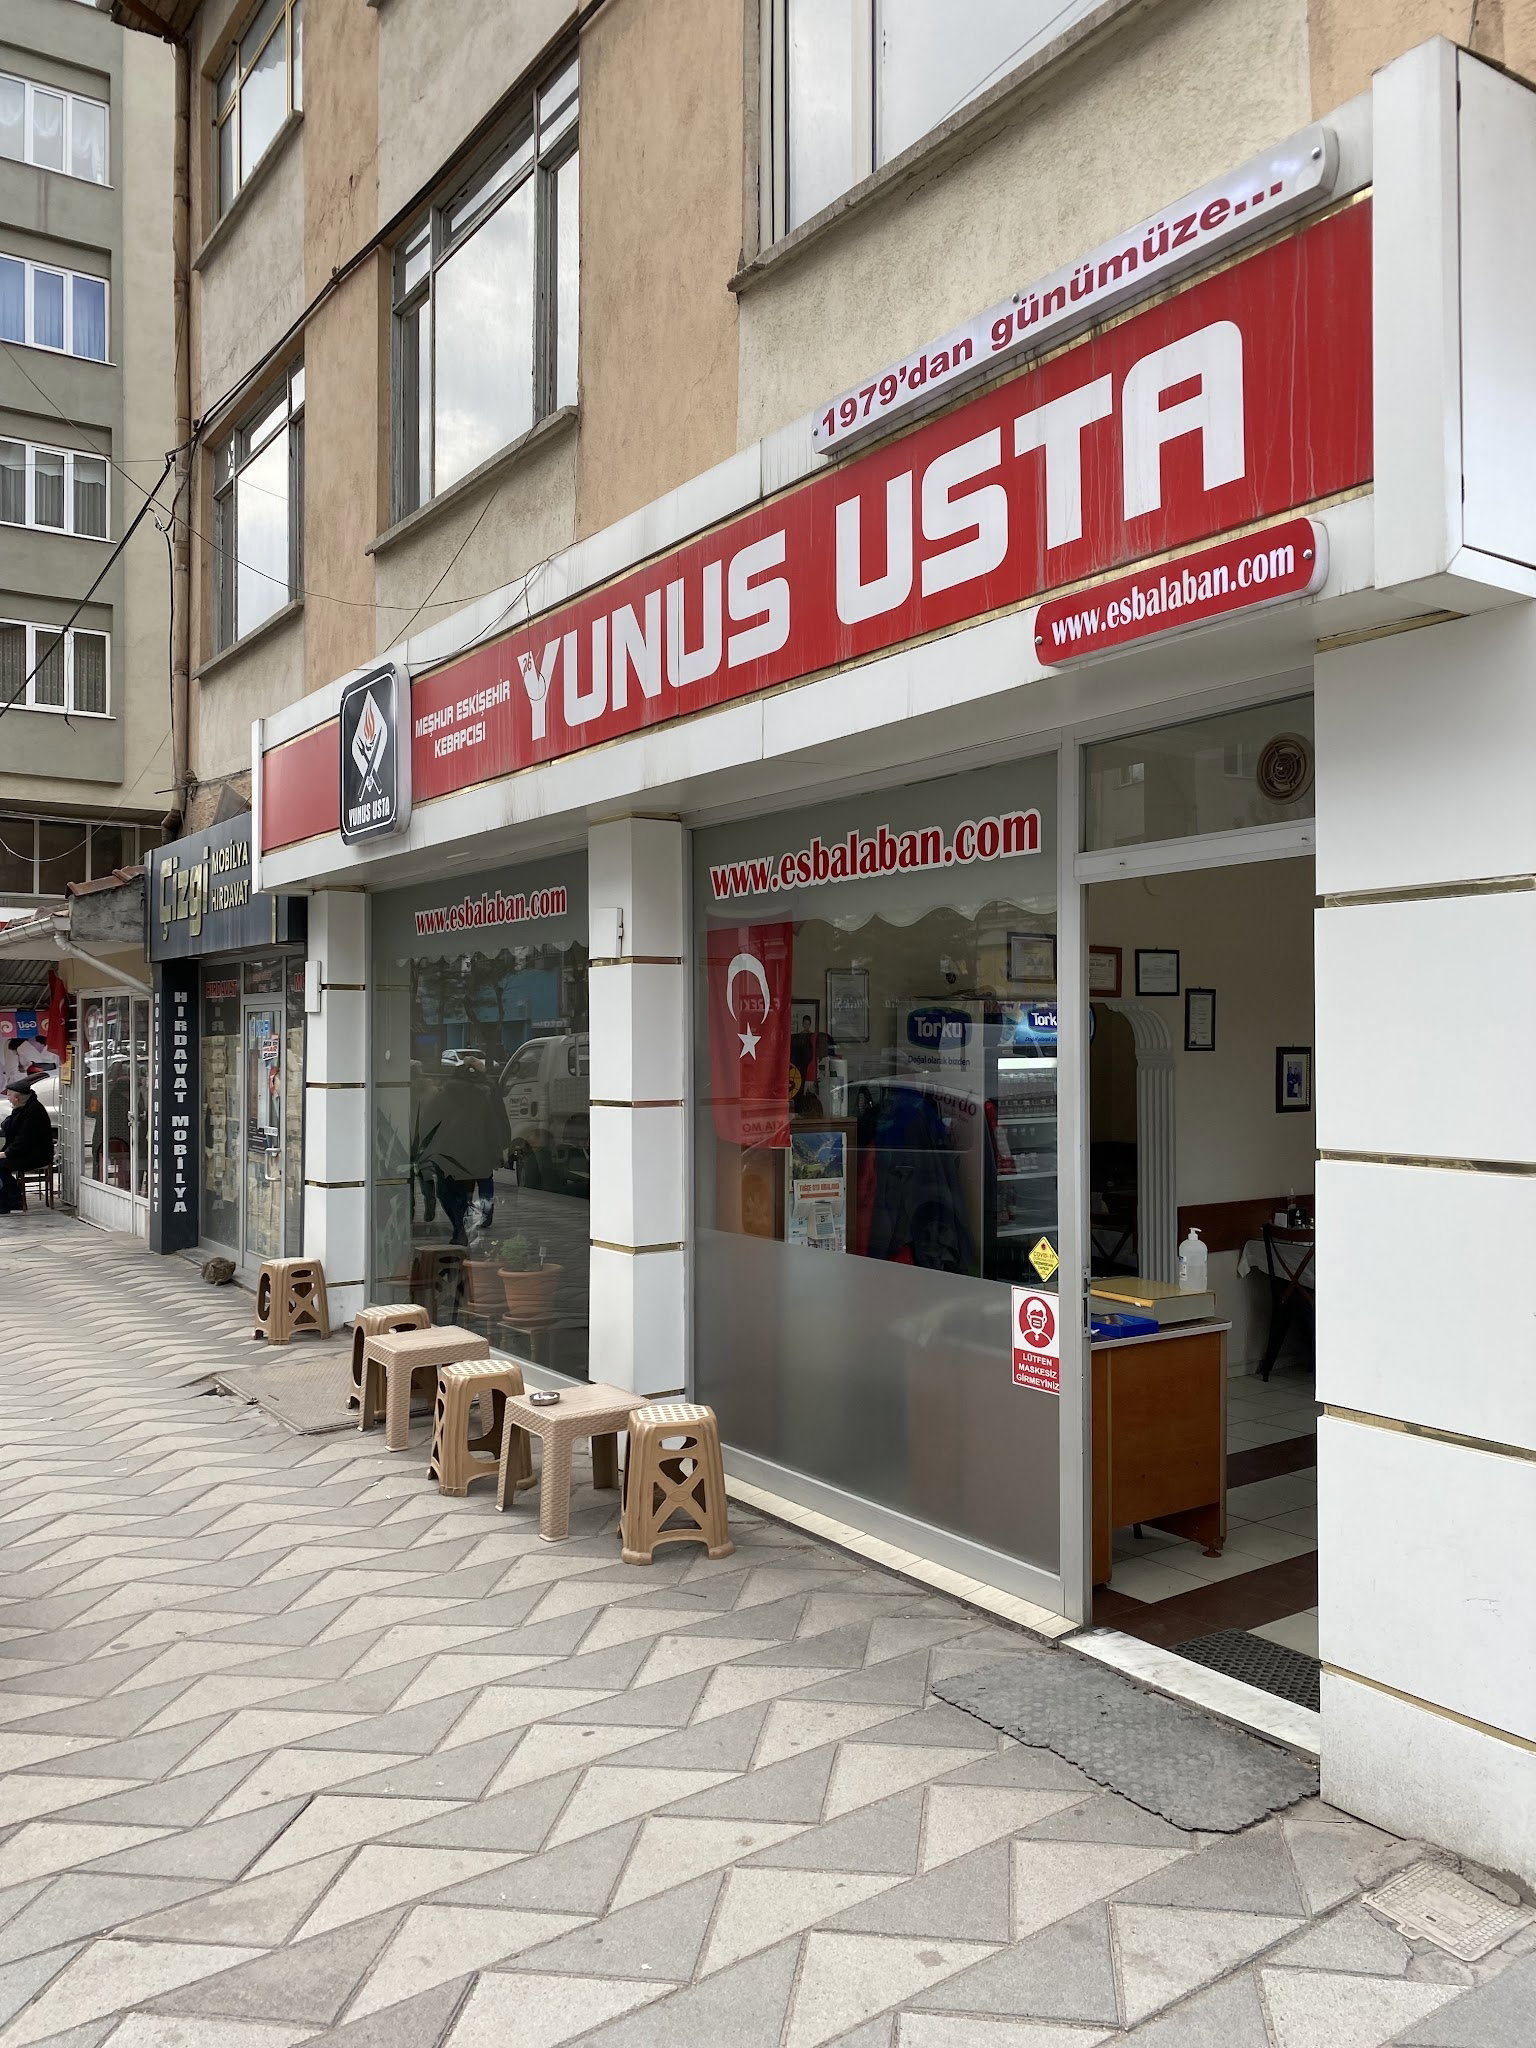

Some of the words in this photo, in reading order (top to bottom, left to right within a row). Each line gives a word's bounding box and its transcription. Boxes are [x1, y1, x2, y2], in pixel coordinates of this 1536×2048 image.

[821, 334, 974, 437] 1979'dan
[991, 180, 1284, 352] günümüze...
[516, 529, 791, 742] YUNUS
[835, 320, 1246, 625] USTA
[1051, 543, 1296, 646] www.esbalaban.com
[415, 704, 454, 738] MEŞHUR
[456, 678, 511, 717] ESKİŞEHİR
[434, 720, 486, 759] KEBAPCISI
[348, 800, 371, 828] YUNUS
[372, 795, 391, 822] USTA
[211, 838, 249, 875] MOBİLYA
[711, 810, 1040, 899] www.esbalaban.com
[159, 845, 209, 941] Çizgi
[211, 879, 250, 912] HIRDAVAT
[415, 885, 568, 936] www.esbalaban.com
[173, 991, 188, 1103] HIRDAVAT
[913, 1016, 964, 1038] Torku
[171, 1115, 190, 1213] MOBİLYA
[1016, 1373, 1060, 1391] GİRMEYİNİZ
[1018, 1363, 1058, 1380] MASKESİZ
[1022, 1353, 1053, 1366] LÜTFEN
